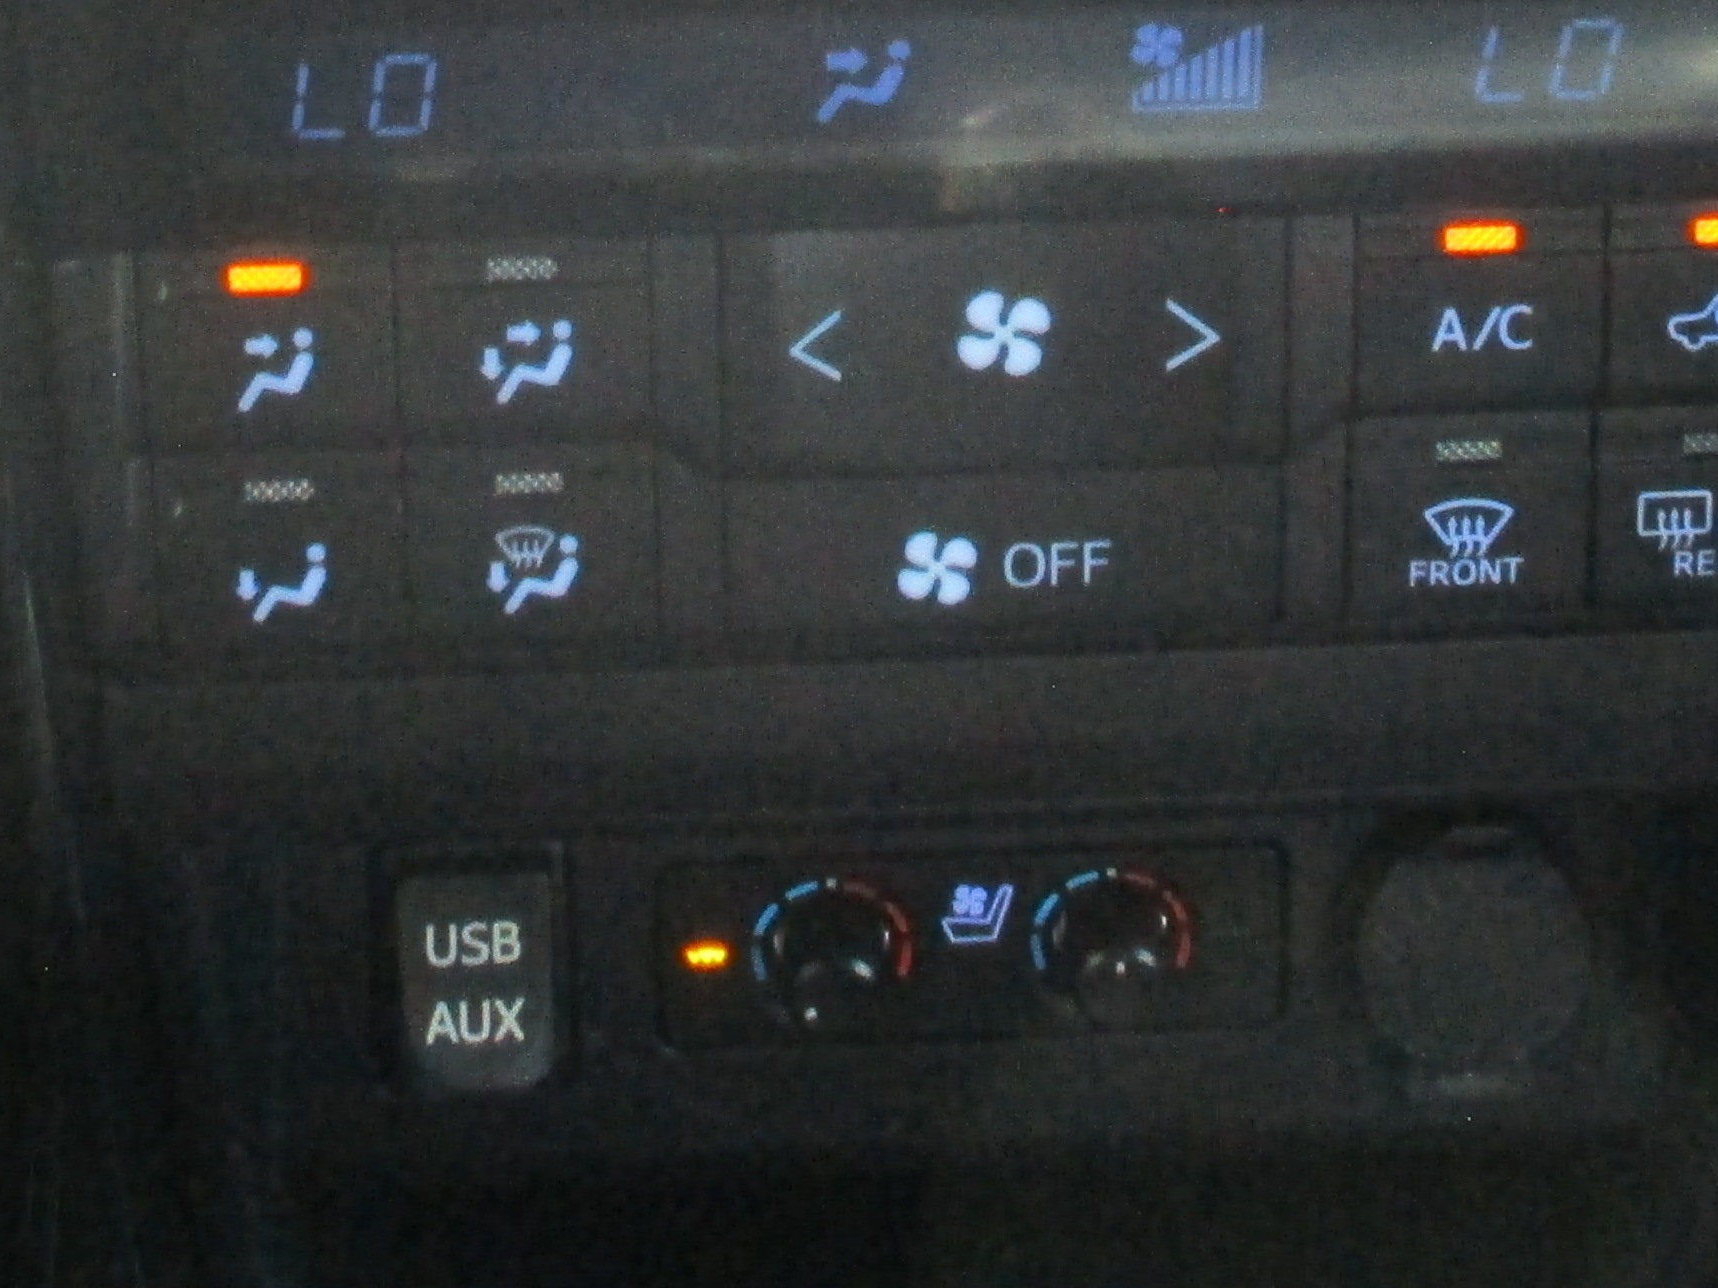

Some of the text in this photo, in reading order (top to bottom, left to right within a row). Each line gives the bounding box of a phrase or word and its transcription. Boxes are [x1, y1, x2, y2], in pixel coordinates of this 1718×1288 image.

[1432, 303, 1533, 353] A/C
[1004, 539, 1111, 590] OFF
[1409, 557, 1524, 588] FRONT
[426, 920, 521, 967] USB
[426, 997, 524, 1045] AUX
